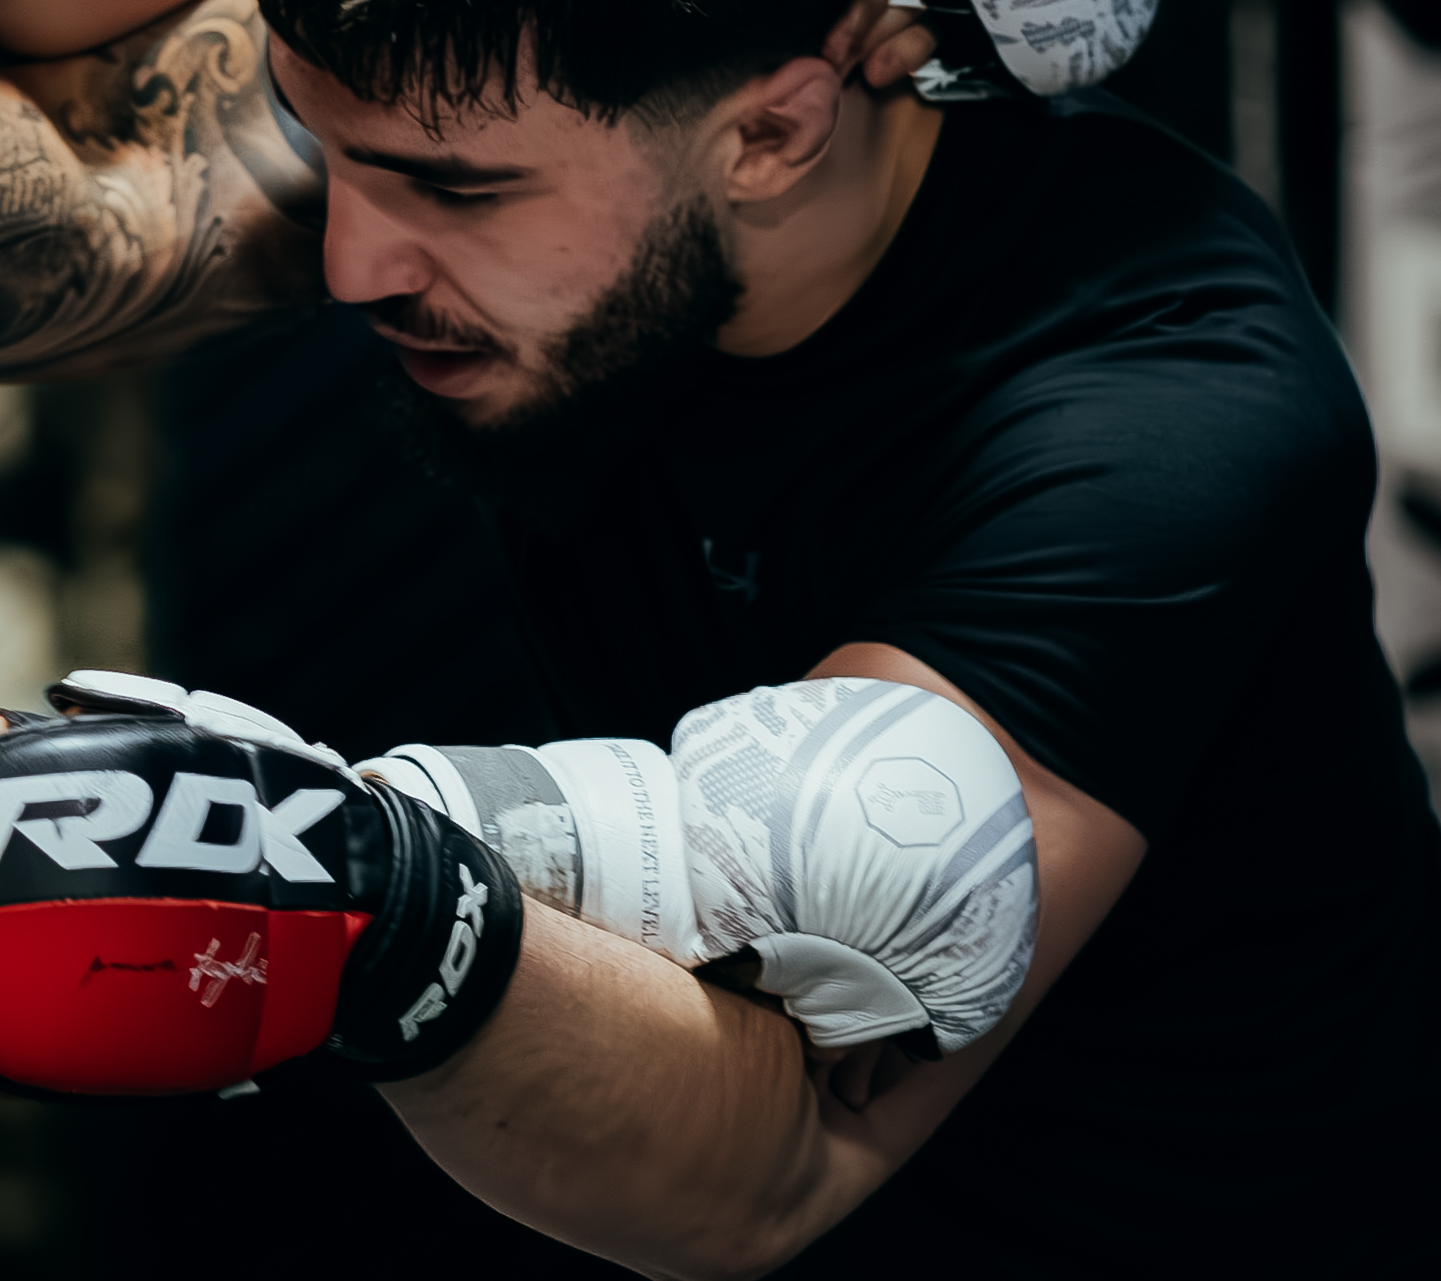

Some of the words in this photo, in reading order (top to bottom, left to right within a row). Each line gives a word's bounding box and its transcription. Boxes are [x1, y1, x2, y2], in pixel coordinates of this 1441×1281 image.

[632, 789, 656, 821] THE
[639, 823, 660, 874] NEXT
[641, 879, 661, 945] LEVEL
[398, 861, 490, 1042] RDX
